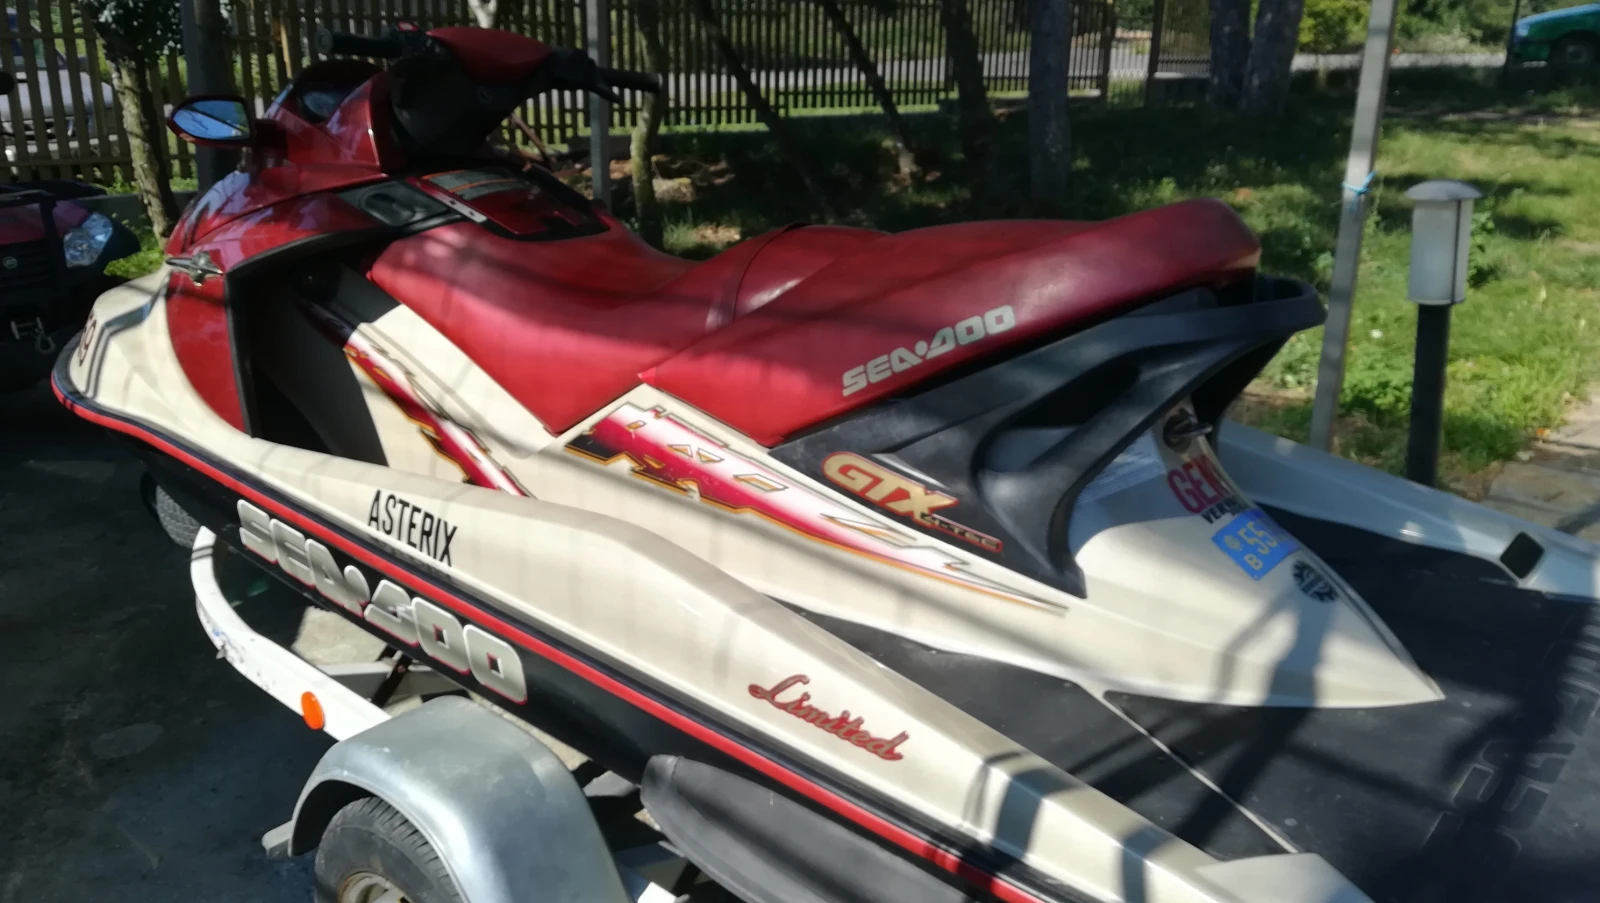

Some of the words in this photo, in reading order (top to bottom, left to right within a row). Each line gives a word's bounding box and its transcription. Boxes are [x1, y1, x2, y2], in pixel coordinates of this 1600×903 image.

[822, 452, 959, 527] GTX
[367, 490, 457, 566] ASTERIX
[748, 674, 910, 761] Limited
